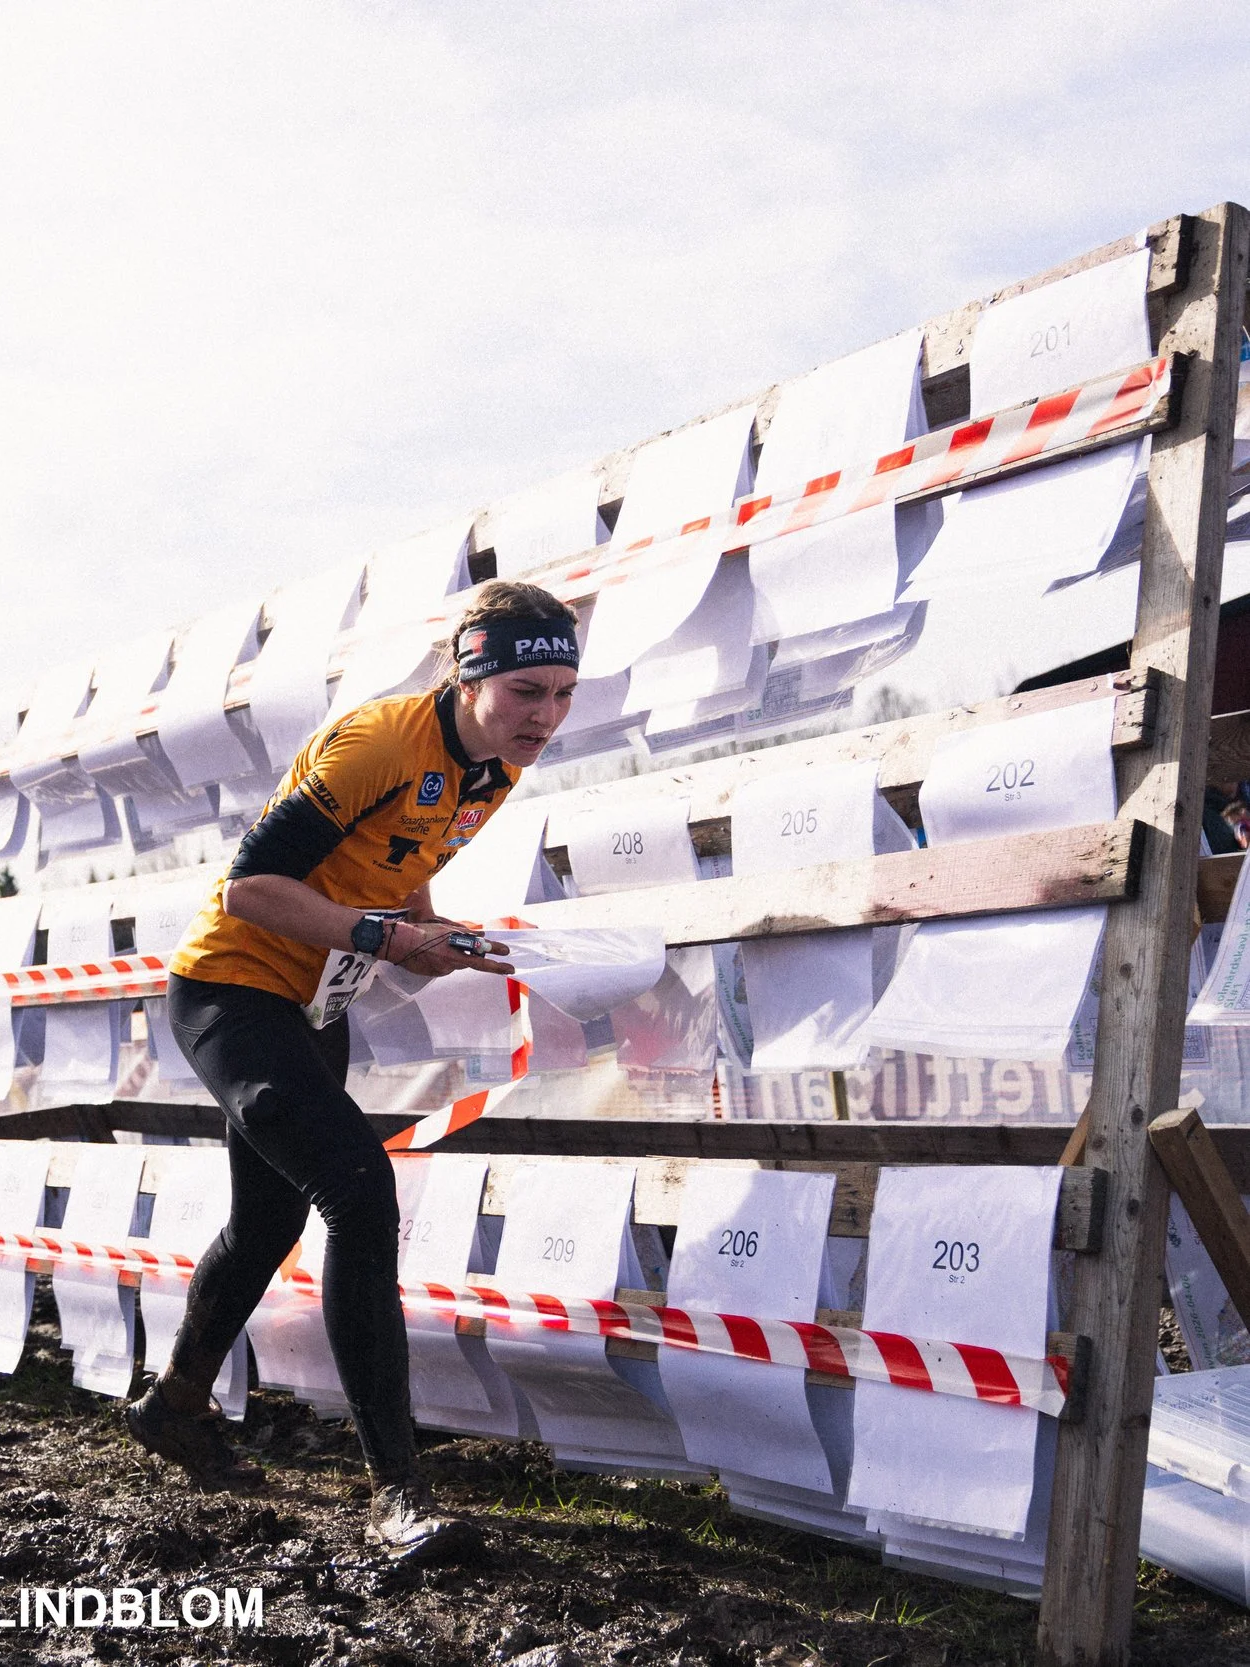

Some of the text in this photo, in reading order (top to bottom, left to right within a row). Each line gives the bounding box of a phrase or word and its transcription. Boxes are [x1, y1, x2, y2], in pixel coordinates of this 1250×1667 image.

[1029, 321, 1071, 359] 201
[425, 781, 440, 792] C4
[986, 759, 1035, 793] 202
[780, 808, 818, 837] 205
[612, 832, 644, 855] 208
[403, 1219, 433, 1242] 212
[718, 1229, 759, 1258] 206
[542, 1236, 575, 1263] 209
[932, 1240, 980, 1273] 203
